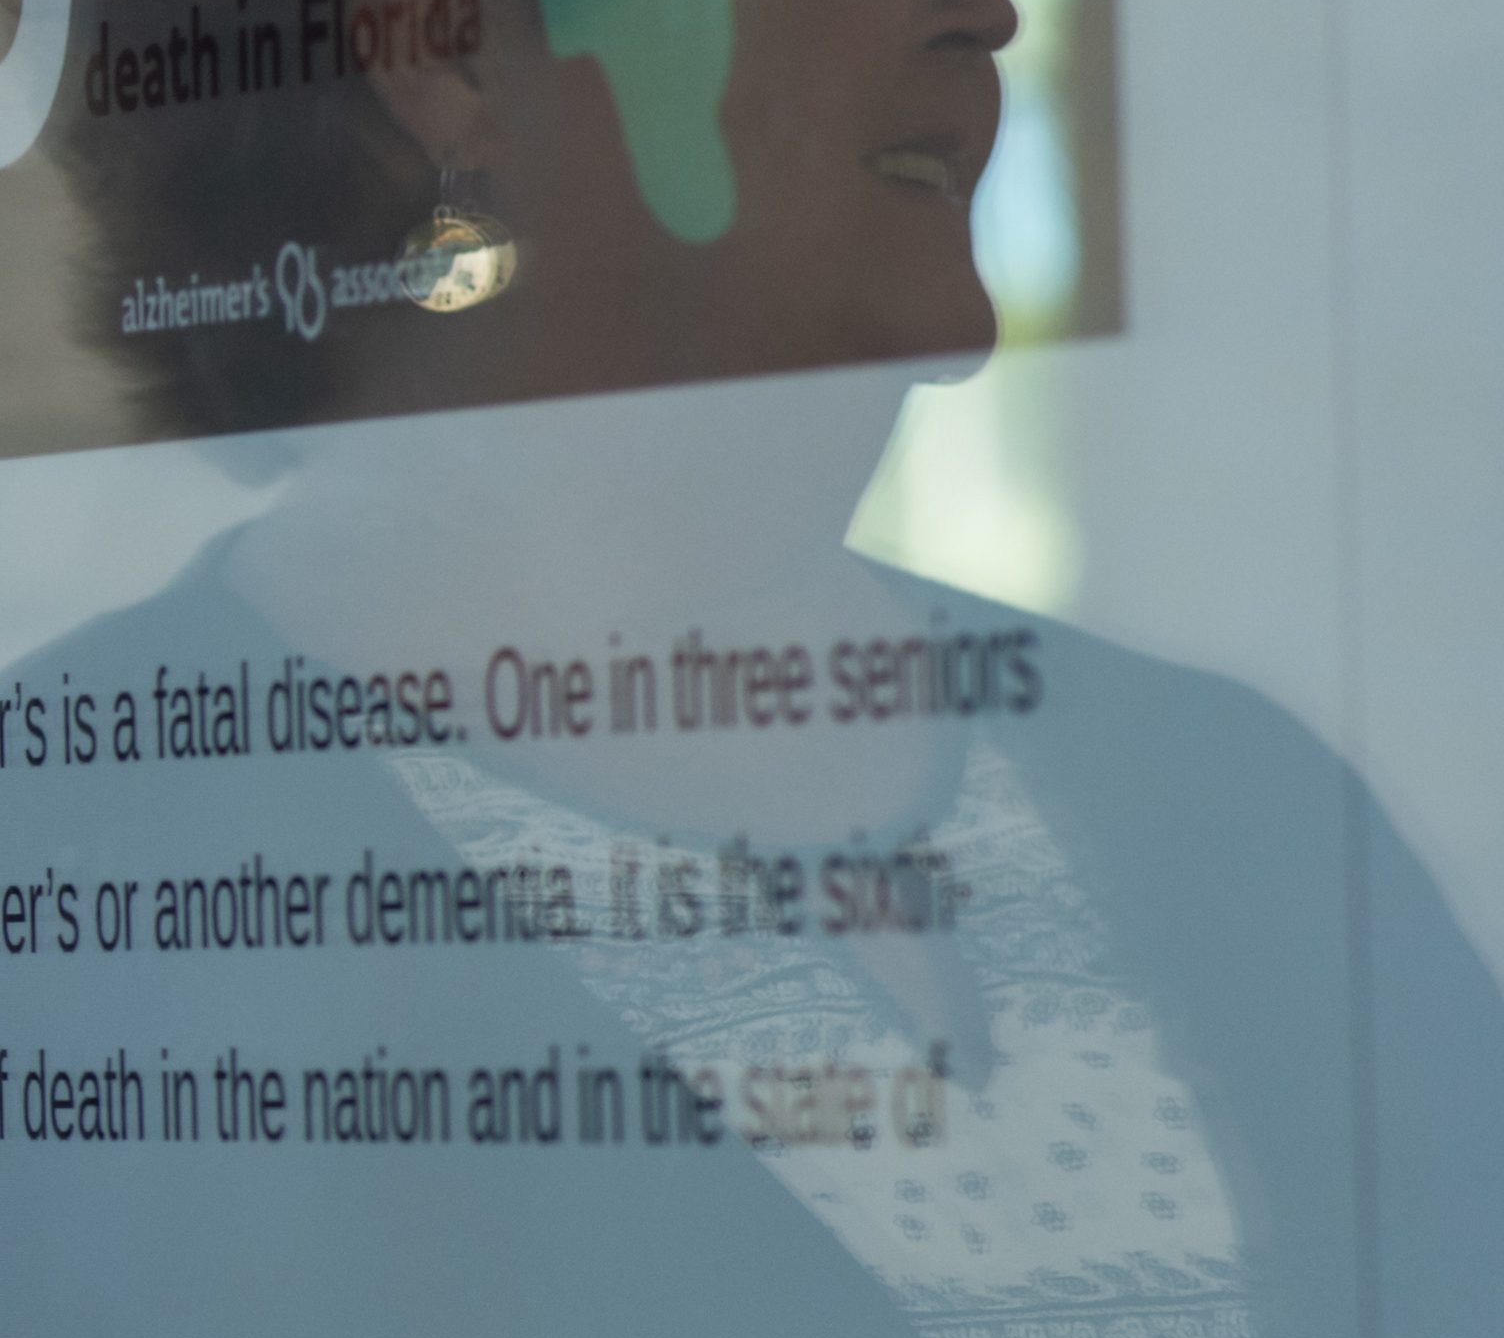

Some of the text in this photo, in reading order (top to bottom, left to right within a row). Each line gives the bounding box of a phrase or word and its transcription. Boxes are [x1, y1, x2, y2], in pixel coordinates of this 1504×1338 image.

[86, 3, 221, 118] death
[121, 263, 272, 335] alzheimer's
[62, 673, 98, 766] is
[113, 688, 140, 762] a
[153, 660, 251, 760] fatal
[267, 655, 469, 753] disease.
[486, 644, 593, 740] One
[608, 631, 658, 734] in
[671, 628, 814, 729] three
[828, 606, 1045, 724] seniors
[96, 880, 139, 952] or
[154, 853, 331, 950] another
[656, 835, 704, 937] is
[23, 1047, 146, 1141] death
[161, 1047, 200, 1142] in
[213, 1047, 287, 1142] the
[302, 1045, 454, 1144] nation
[467, 1044, 564, 1145] and
[576, 1045, 625, 1147] in
[638, 1051, 724, 1148] the
